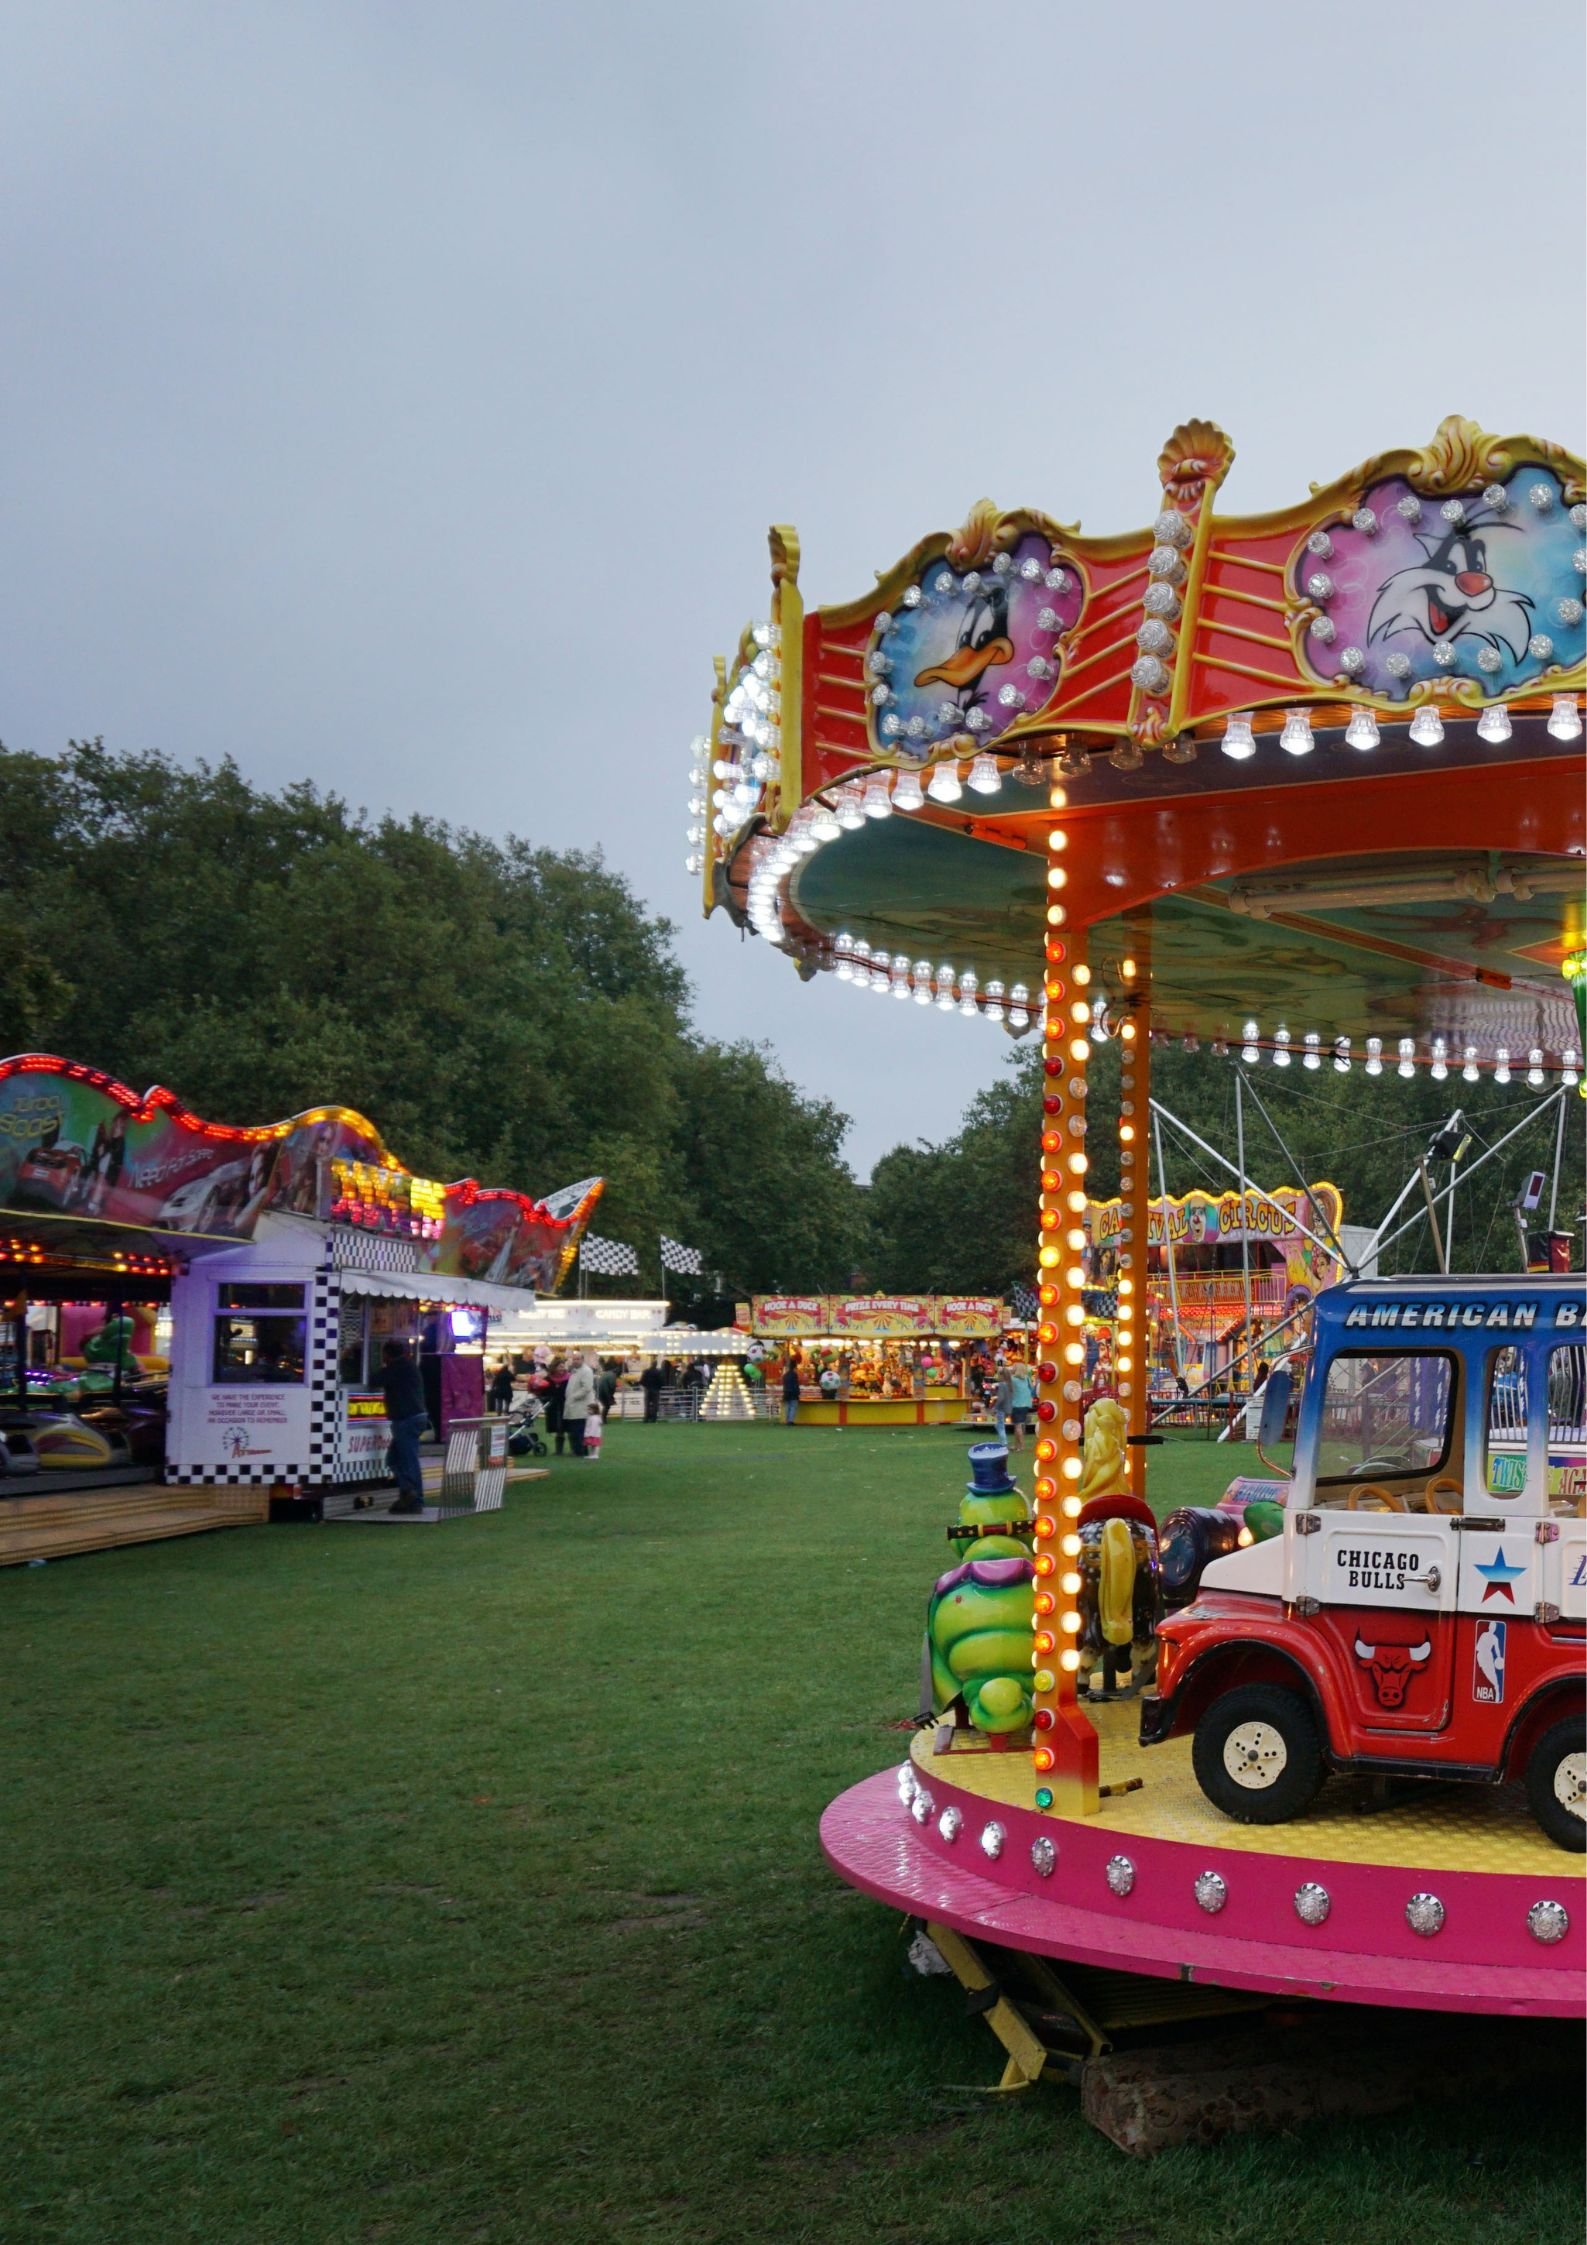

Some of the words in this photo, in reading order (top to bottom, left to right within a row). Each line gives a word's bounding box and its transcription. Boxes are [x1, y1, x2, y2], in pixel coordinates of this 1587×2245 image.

[1219, 1198, 1297, 1235] CIRCUS
[788, 1300, 798, 1309] A
[872, 1300, 898, 1309] EVERY
[900, 1301, 920, 1312] TIME
[967, 1301, 975, 1310] A
[595, 1309, 627, 1319] CANDY
[1346, 1302, 1538, 1327] AMERICAN
[1555, 1302, 1586, 1327] B
[1337, 1549, 1420, 1572] CHICAGO
[1348, 1570, 1406, 1591] BULLS
[1476, 1686, 1494, 1700] NBA
